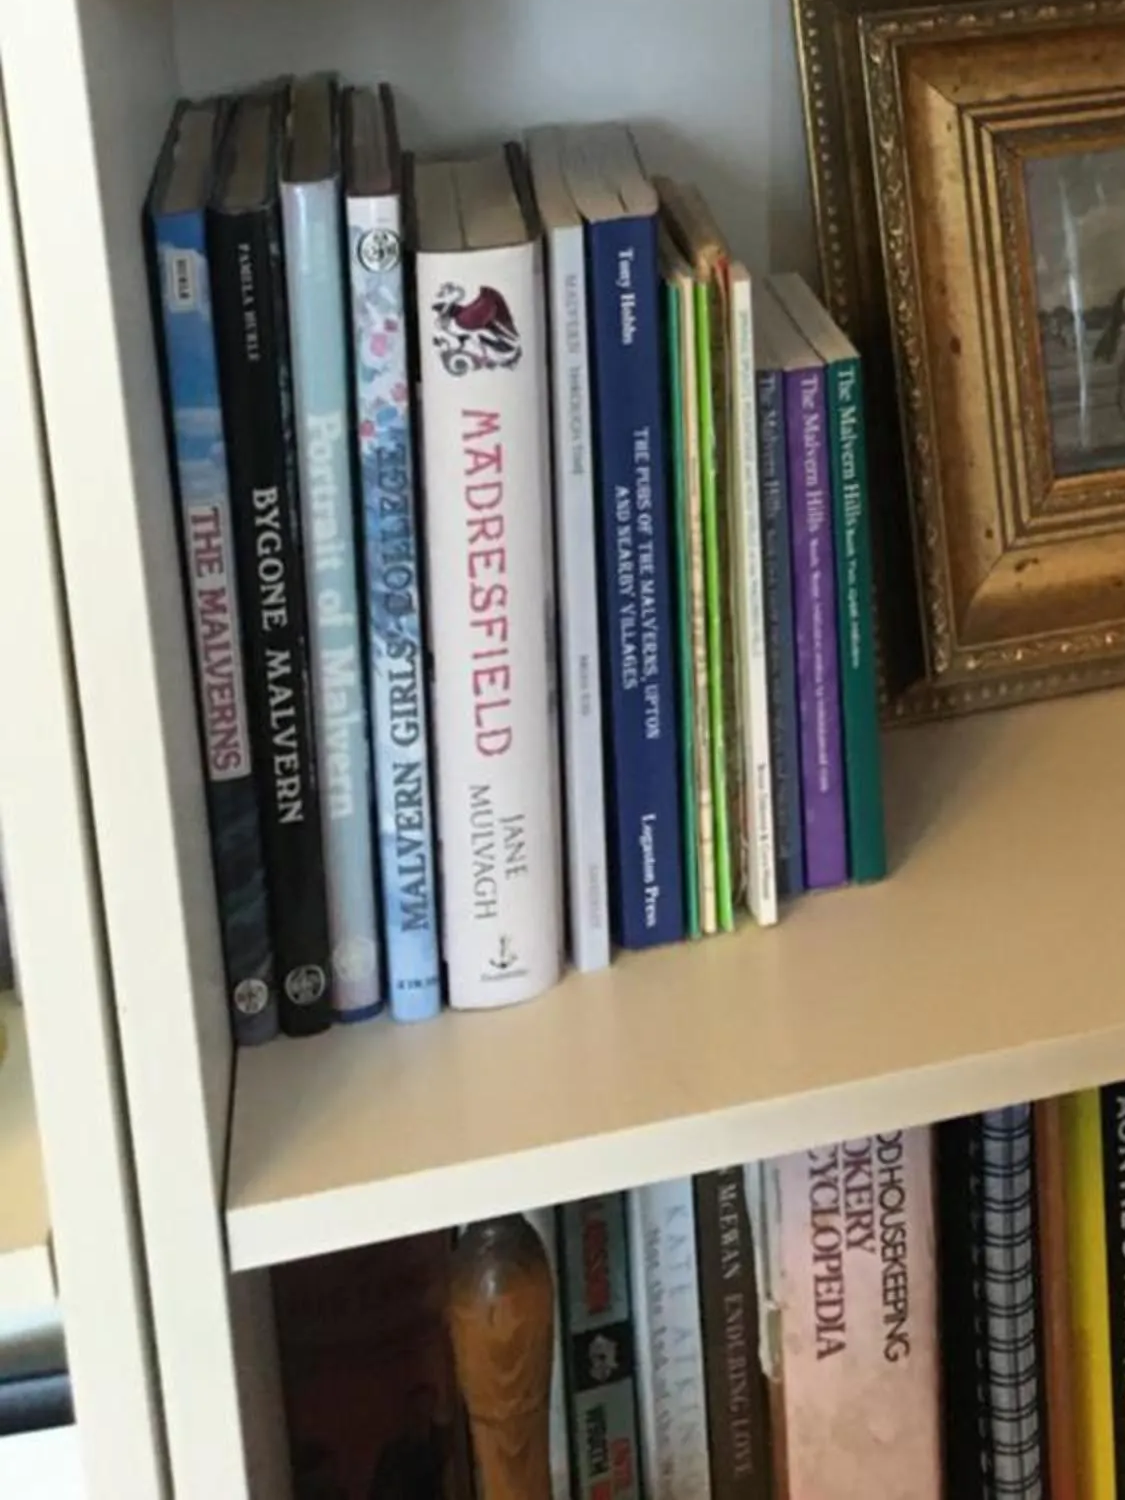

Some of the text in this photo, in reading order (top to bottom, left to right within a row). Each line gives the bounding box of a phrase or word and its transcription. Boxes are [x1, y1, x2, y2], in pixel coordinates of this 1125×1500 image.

[237, 242, 254, 306] PAMELA
[800, 375, 819, 408] The
[837, 369, 855, 404] The
[633, 428, 650, 464] THE
[801, 412, 823, 488] Malvern
[839, 405, 860, 481] Malvern
[614, 484, 632, 523] AND
[635, 468, 652, 510] PUBS
[640, 512, 653, 536] OF
[805, 489, 826, 533] Hills
[843, 482, 863, 526] Hills
[460, 407, 513, 758] MADRESFIELD
[640, 541, 655, 575] THE
[188, 505, 242, 772] THE MALVERNS
[306, 413, 365, 821] Portrait of Malvern
[618, 602, 639, 690] VILLAGES
[251, 486, 306, 825] BYGONE MALVERN
[643, 684, 660, 741] UPTON
[391, 762, 432, 933] MALVERN
[467, 784, 498, 921] MULVAGH
[498, 812, 529, 881] JANE
[842, 1140, 877, 1256] OKERY
[878, 1168, 911, 1365] HOUSEKEEPING
[717, 1184, 754, 1480] McEWAN ENDURING LOVE
